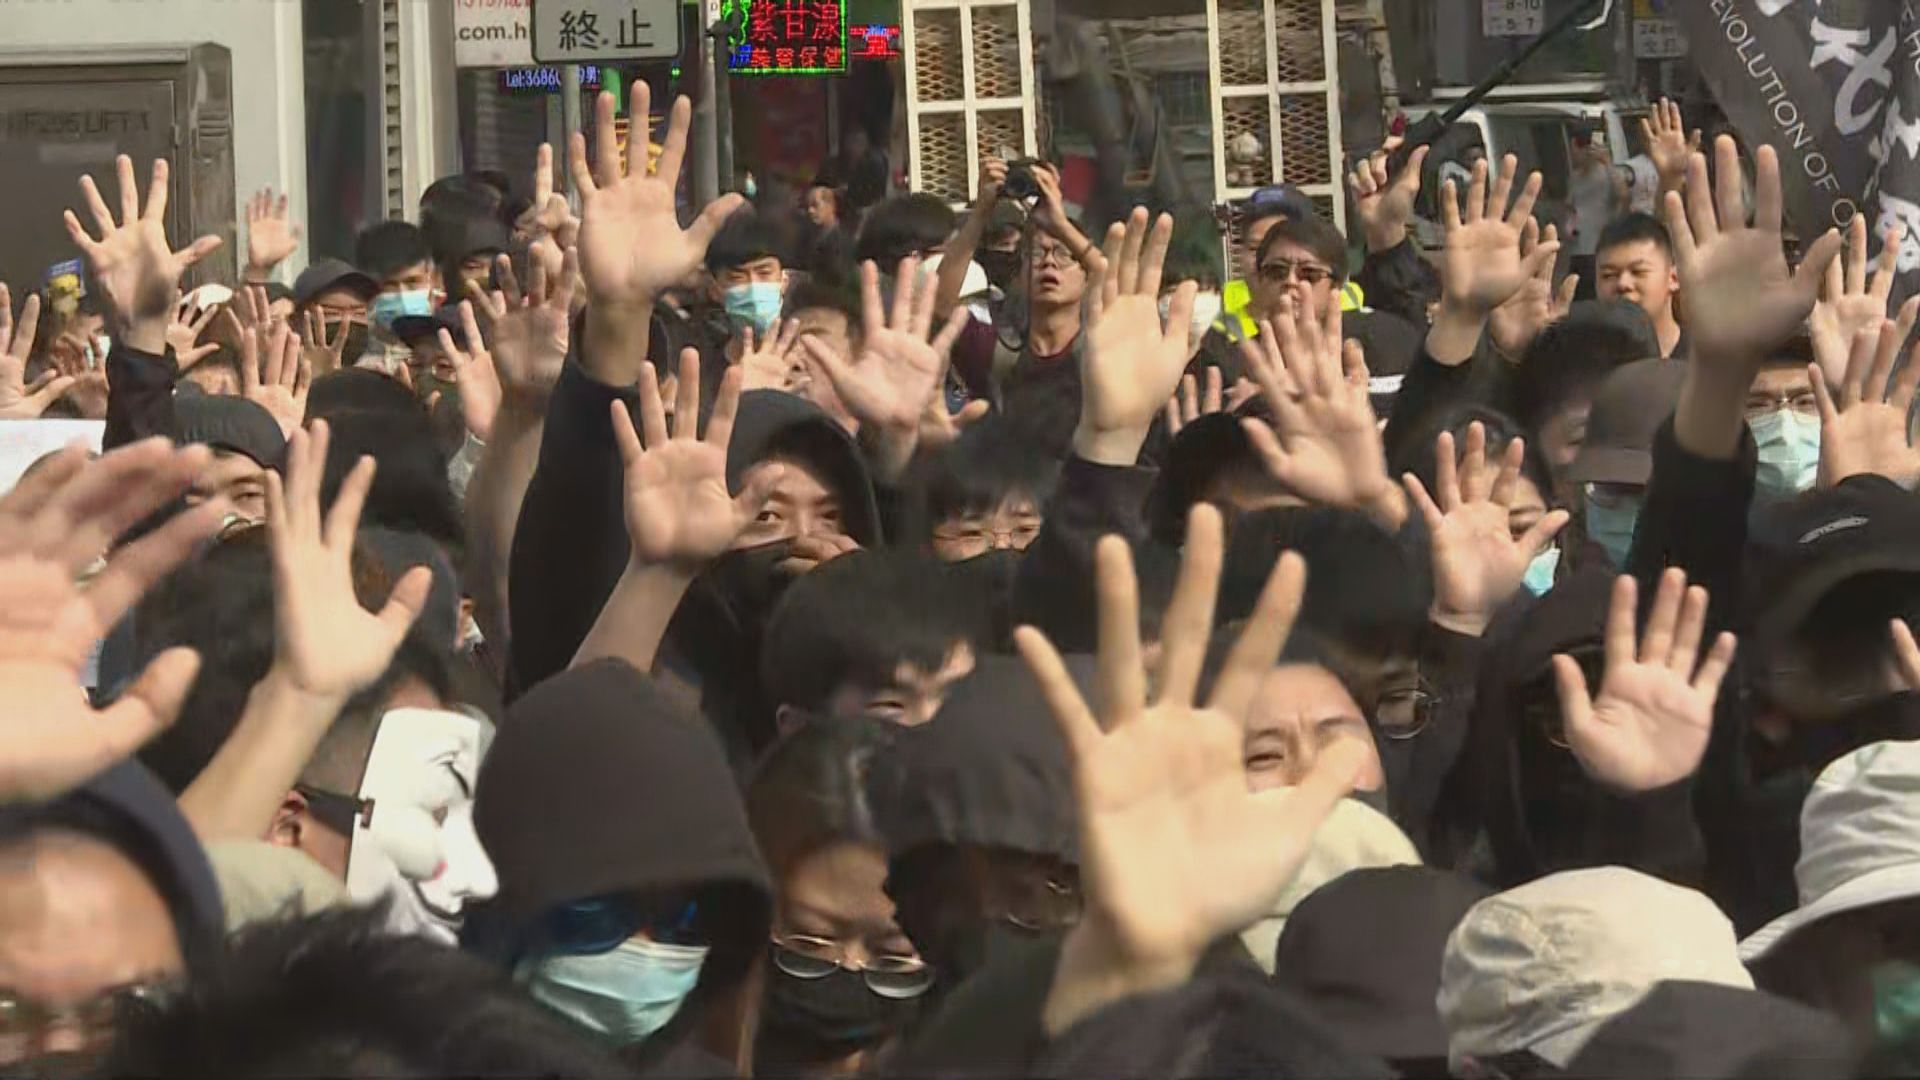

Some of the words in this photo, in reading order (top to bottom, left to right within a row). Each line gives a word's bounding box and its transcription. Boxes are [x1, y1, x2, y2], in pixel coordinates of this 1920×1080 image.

[559, 8, 654, 51] 終止
[1711, 0, 1813, 149] EVOLUTION
[1803, 152, 1841, 192] OF
